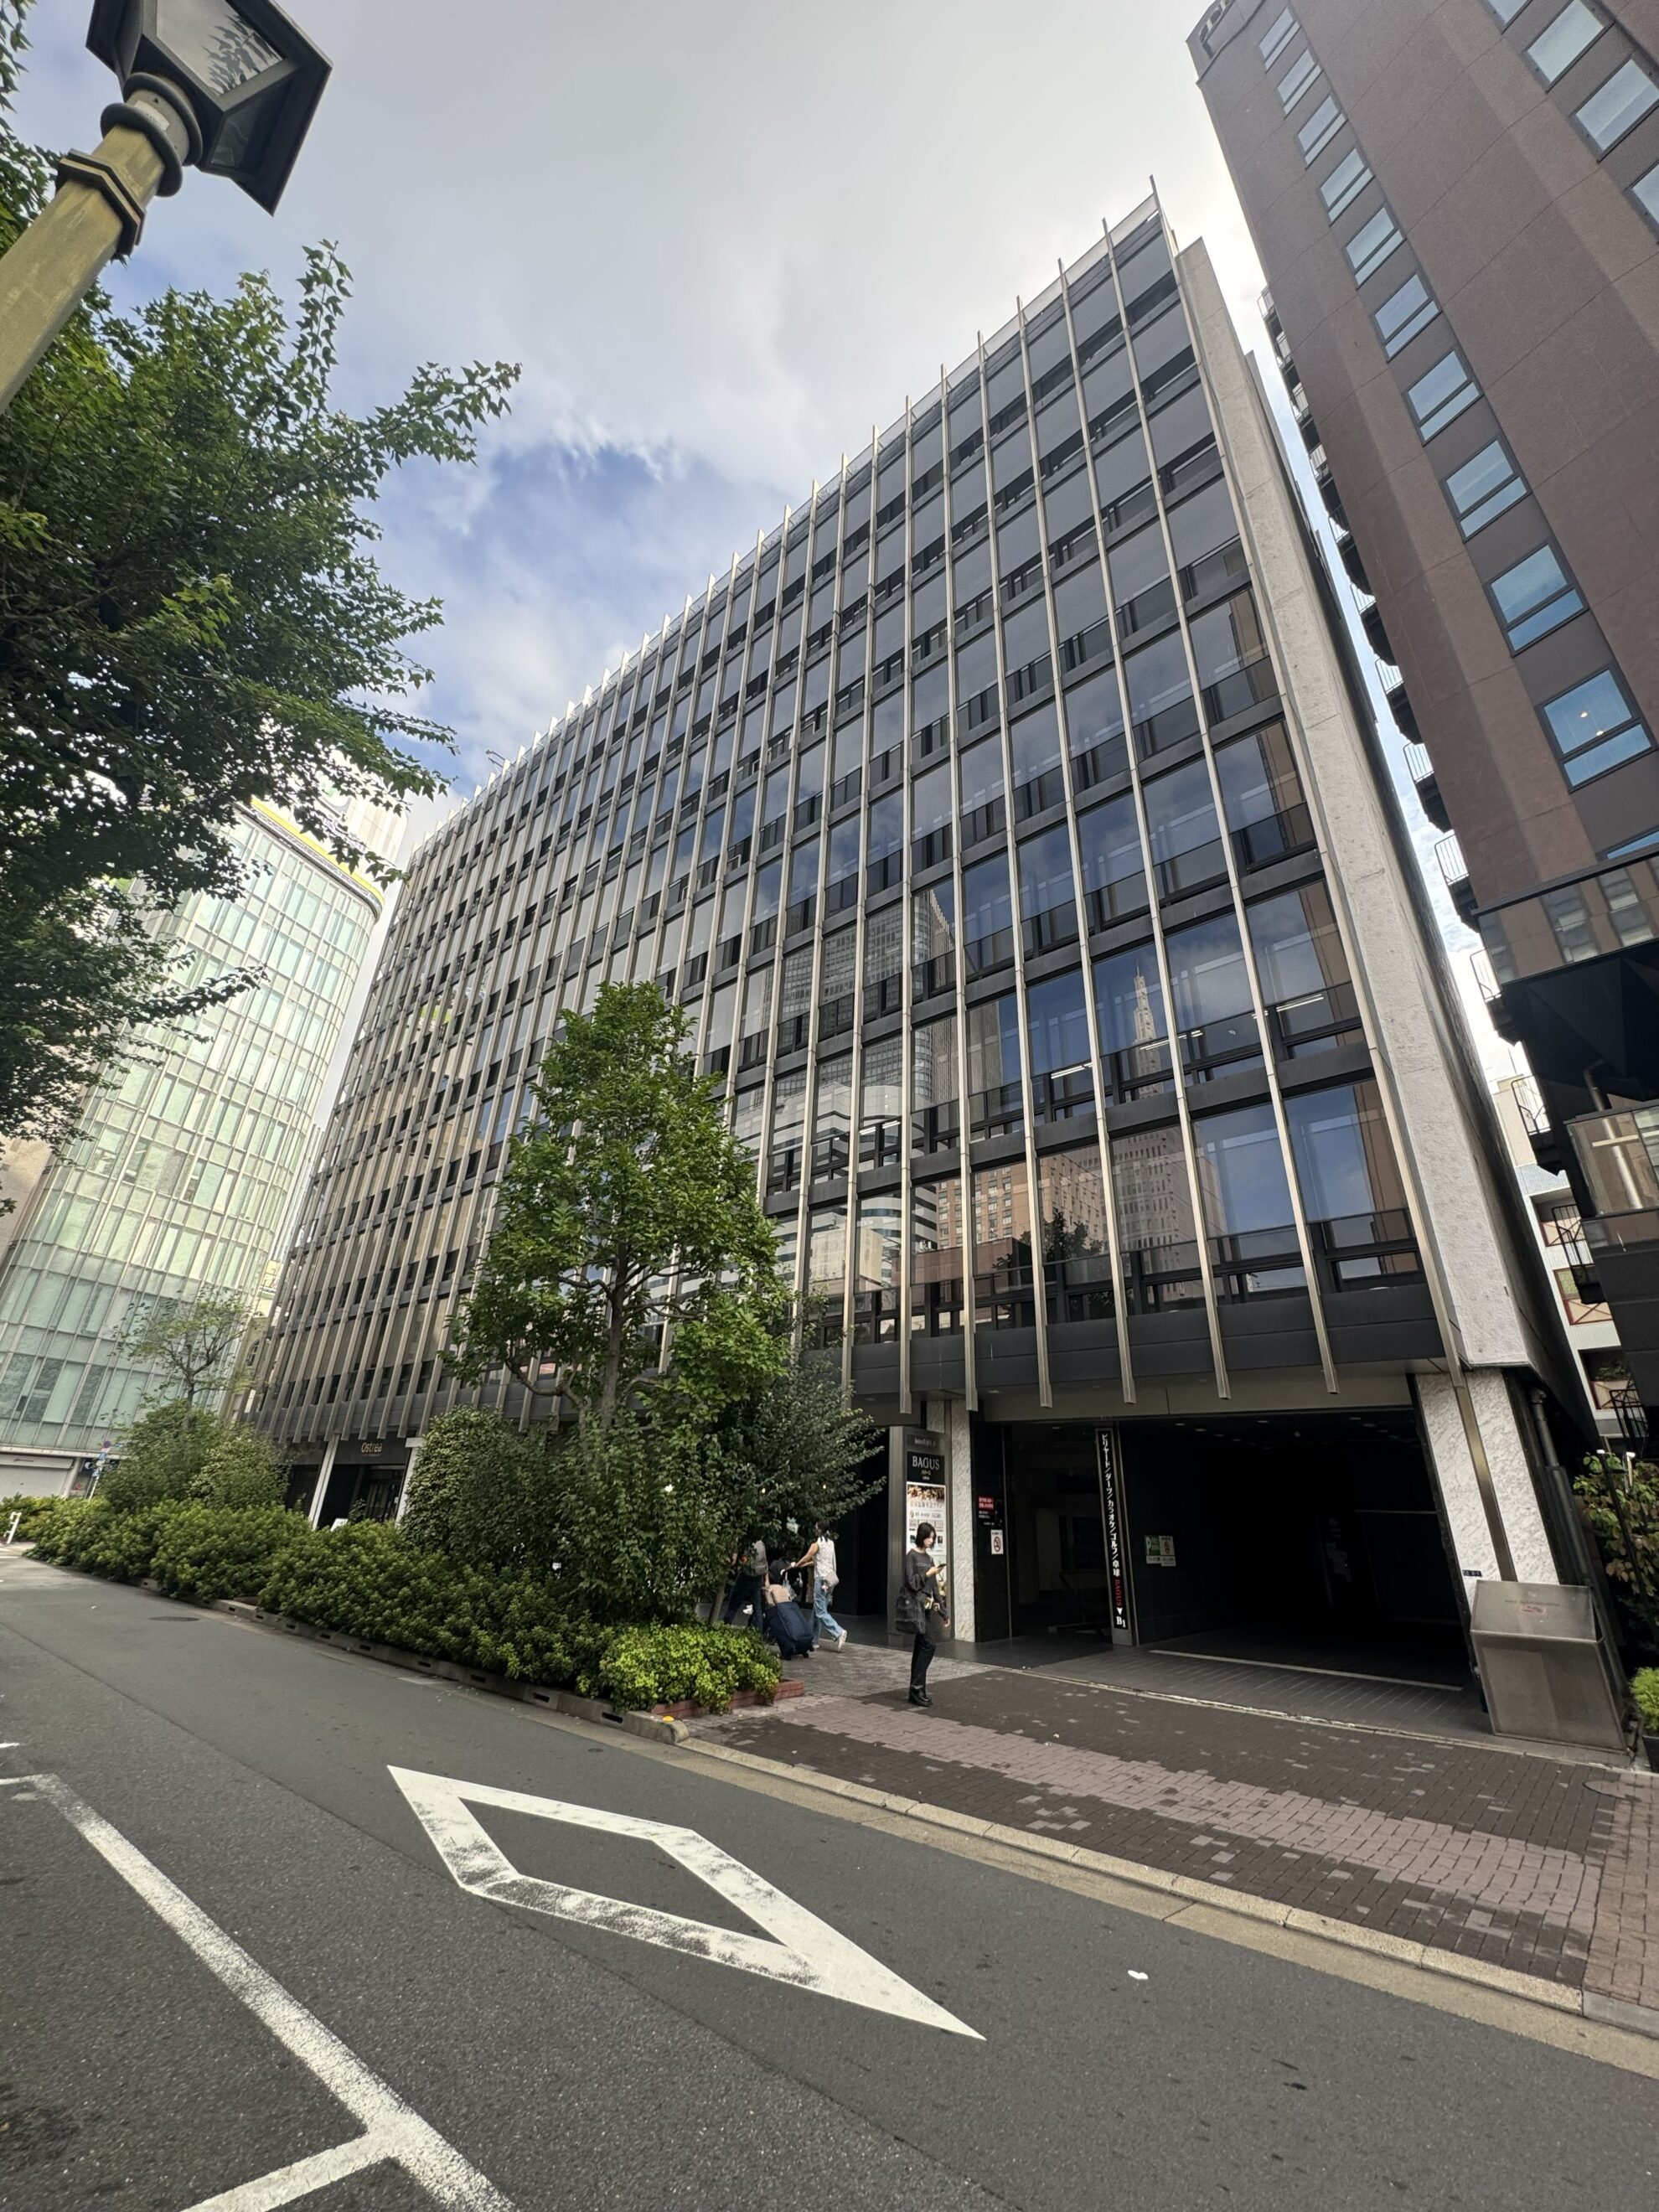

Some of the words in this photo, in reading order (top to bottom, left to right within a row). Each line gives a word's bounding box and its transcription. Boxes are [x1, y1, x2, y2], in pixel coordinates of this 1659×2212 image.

[912, 1455, 940, 1470] BAGUS
[1114, 1579, 1123, 1608] BAGUS
[1116, 1615, 1126, 1628] B1
